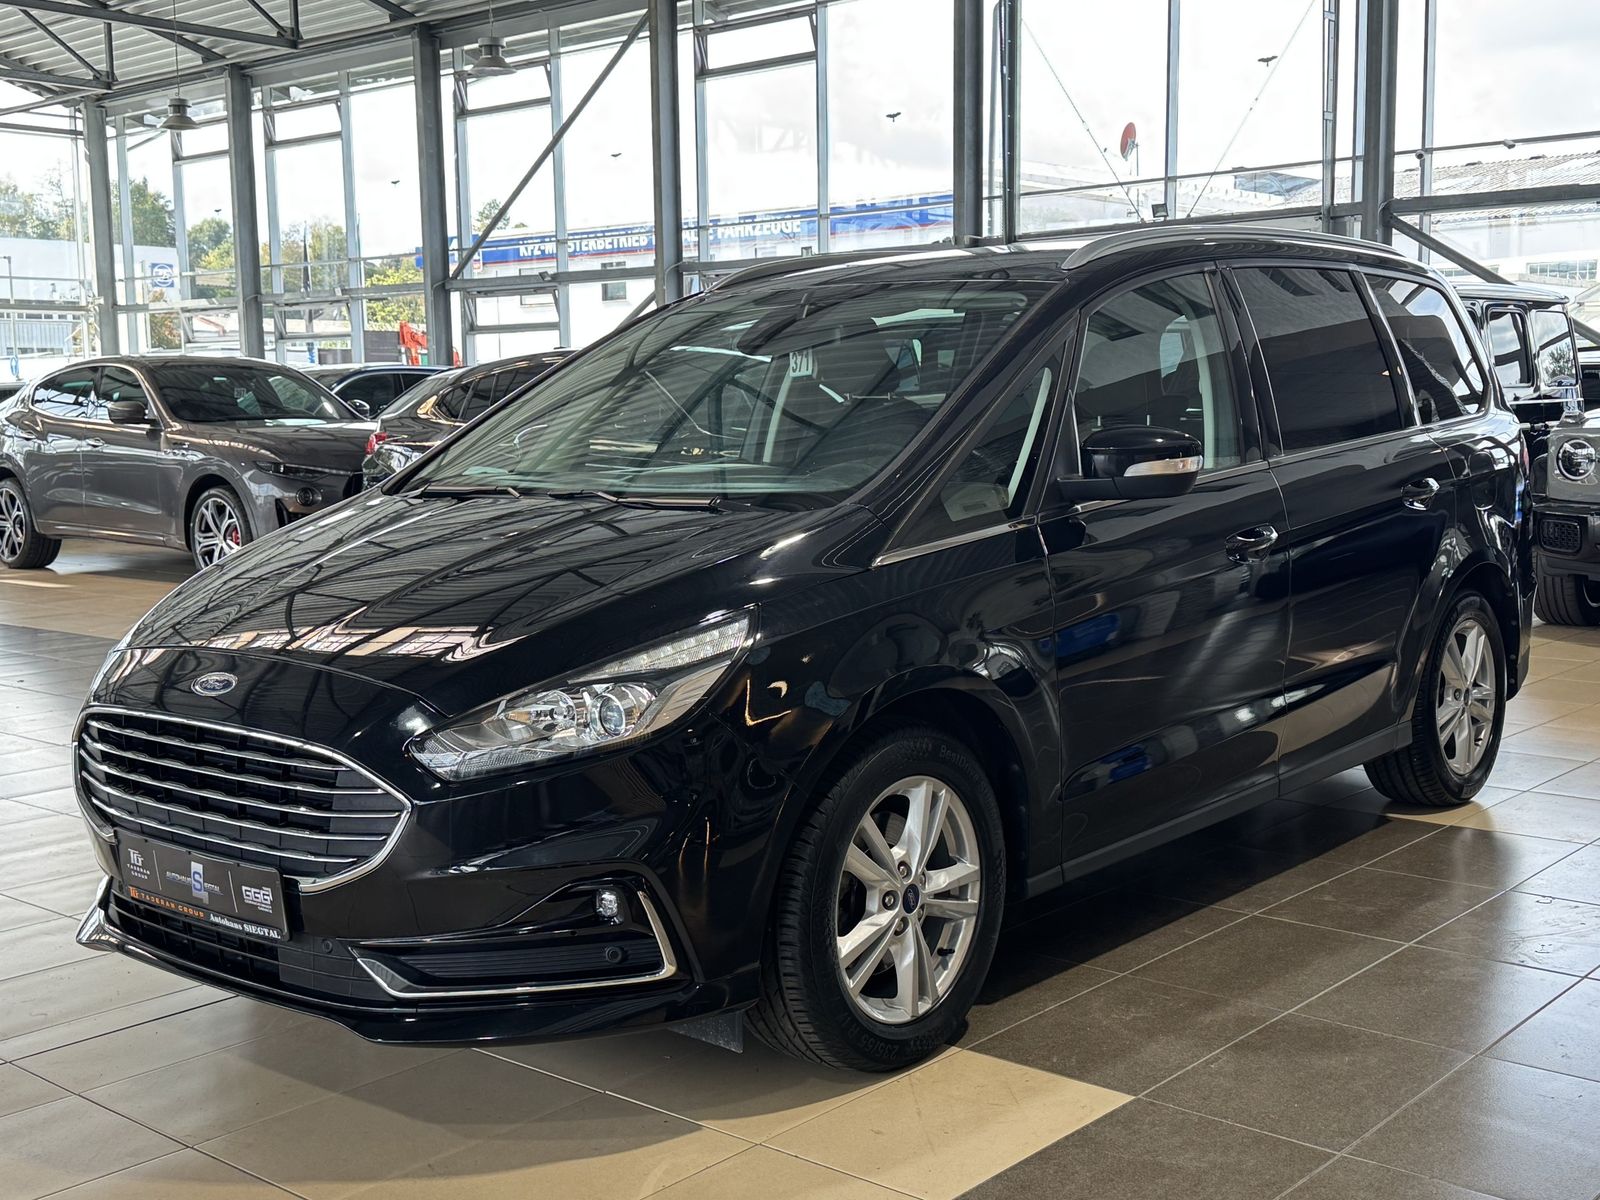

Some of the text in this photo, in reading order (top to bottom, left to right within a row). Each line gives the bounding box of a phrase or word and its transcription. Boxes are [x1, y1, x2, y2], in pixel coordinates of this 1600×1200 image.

[519, 231, 648, 257] KFZ-MSTERBETRIEB
[791, 351, 809, 373] 371
[243, 923, 281, 939] SIEGTAL
